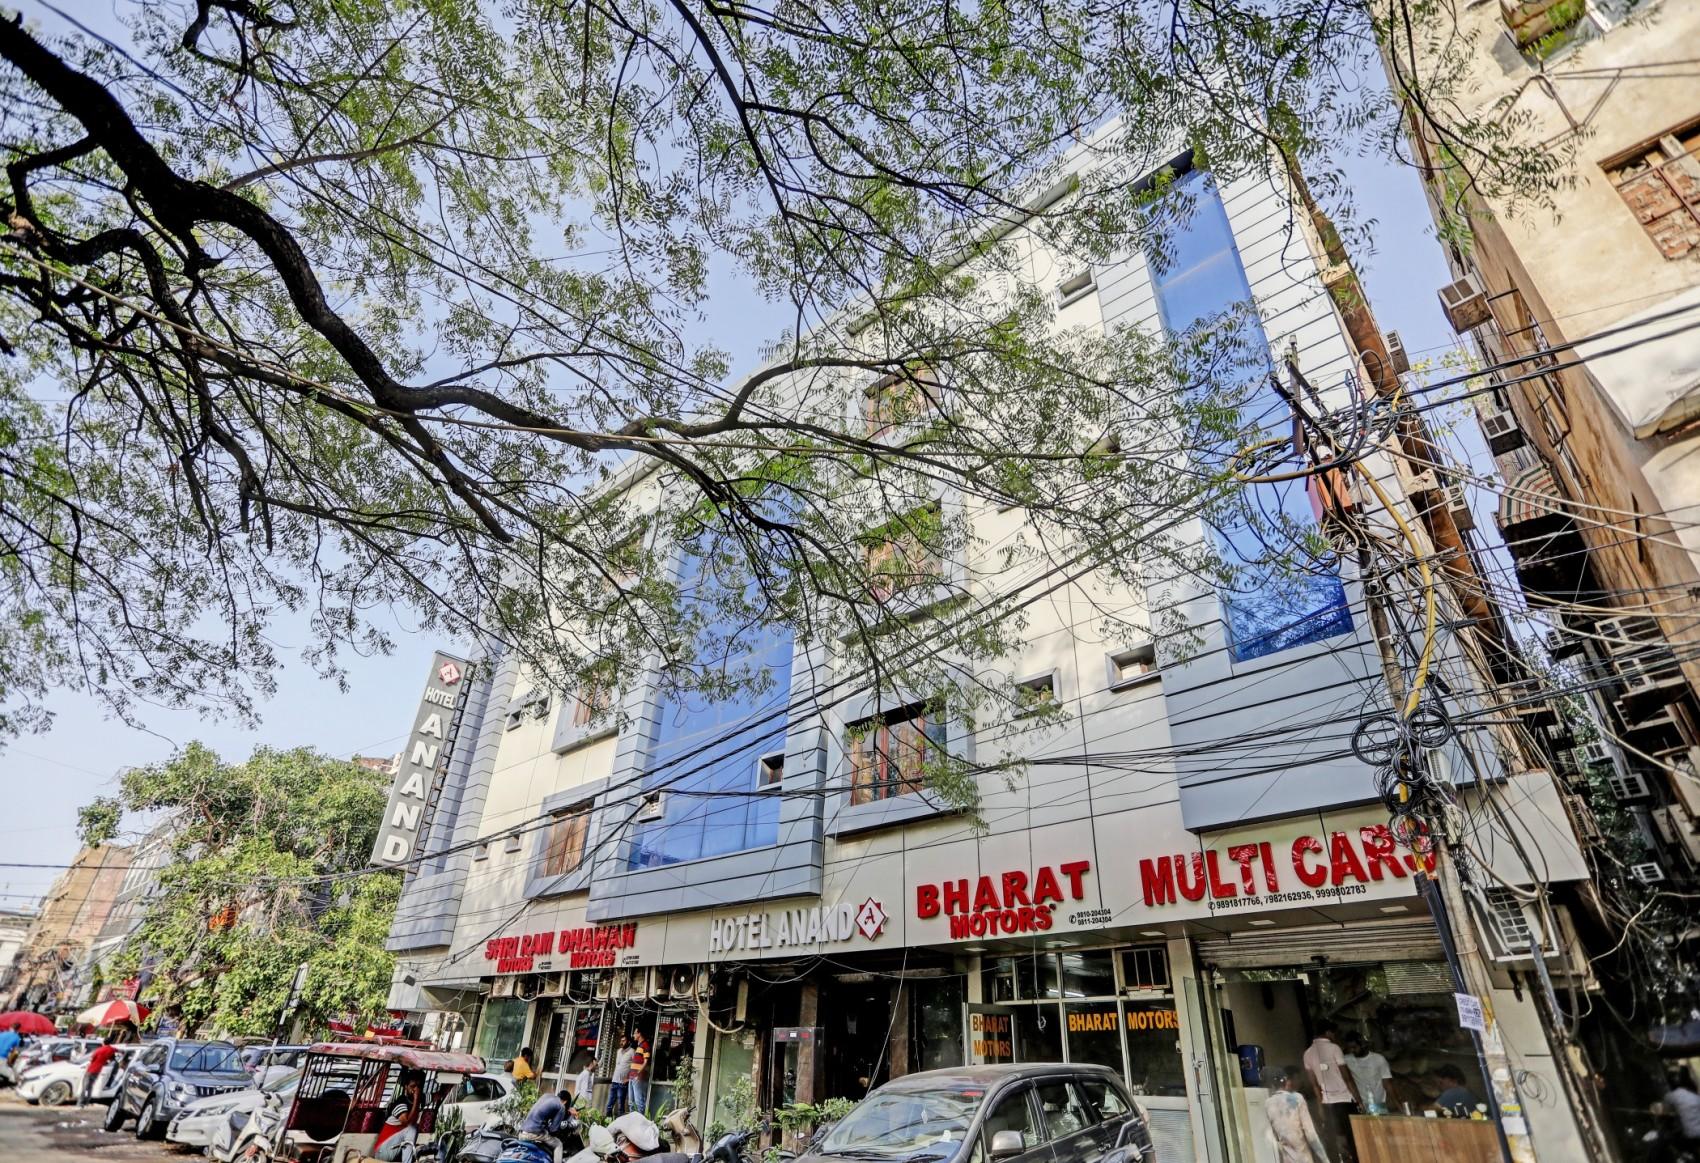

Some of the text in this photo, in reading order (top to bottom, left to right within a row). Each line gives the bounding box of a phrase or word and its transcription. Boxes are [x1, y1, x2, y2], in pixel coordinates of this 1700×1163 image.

[425, 687, 456, 709] HOTEL
[381, 713, 443, 863] ANAND
[916, 860, 1090, 919] BHARAT
[1139, 842, 1279, 908] MULTI
[709, 903, 854, 952] HOTEL ANAND
[950, 904, 1057, 940] MOTORS
[485, 922, 638, 960] SHRI RAM DHAWAN
[496, 957, 534, 973] MOTORS
[570, 950, 617, 969] MOTORS
[972, 1015, 1009, 1033] BHARAT
[1068, 1012, 1118, 1032] BHARAT
[973, 1039, 1011, 1057] MOTORS
